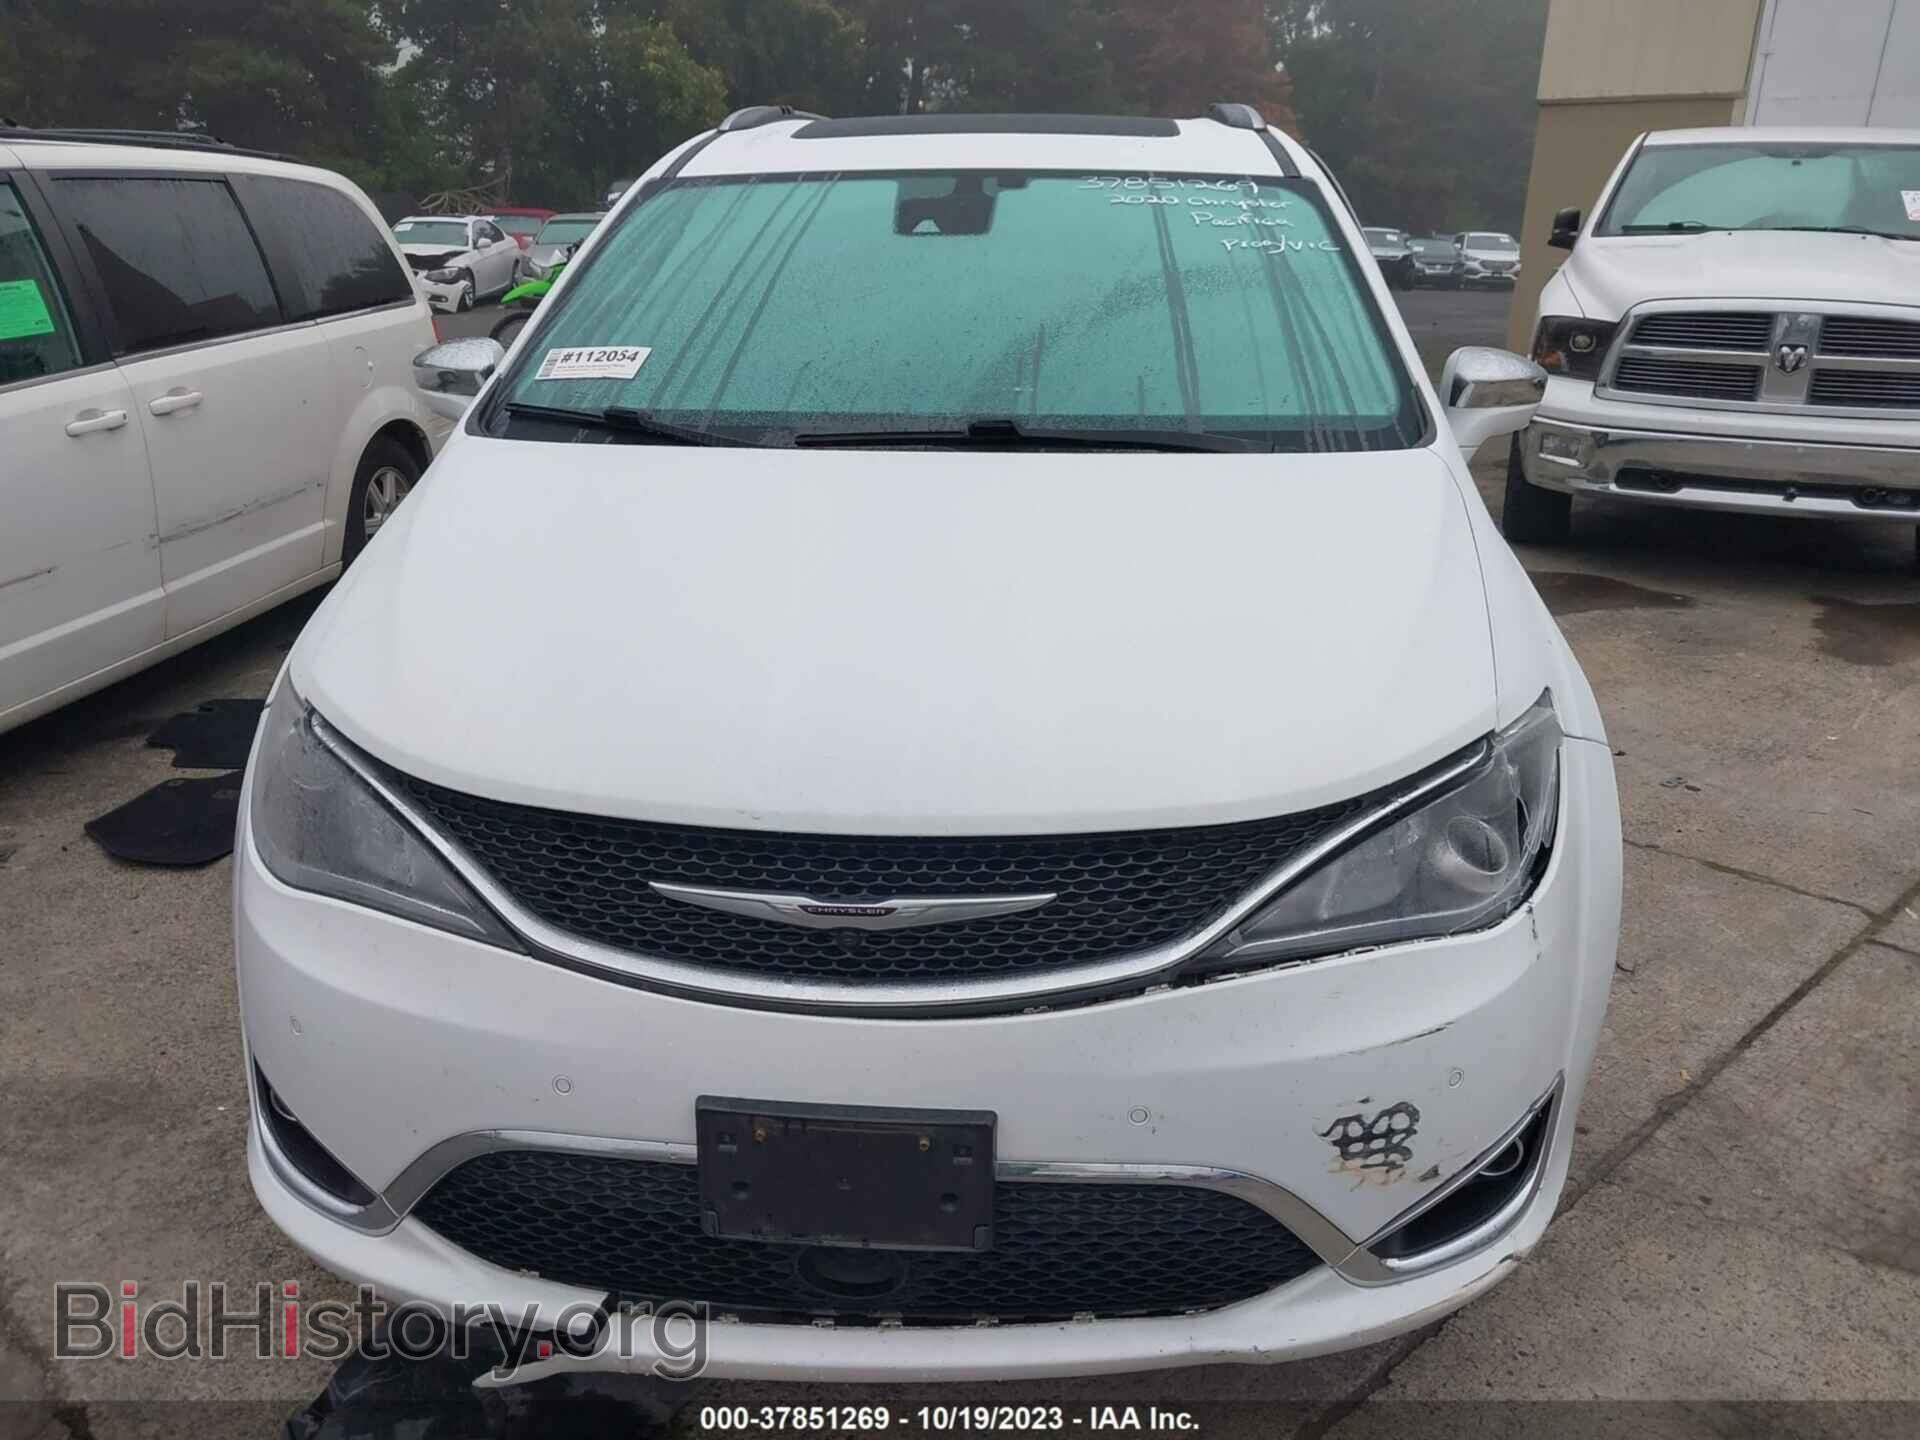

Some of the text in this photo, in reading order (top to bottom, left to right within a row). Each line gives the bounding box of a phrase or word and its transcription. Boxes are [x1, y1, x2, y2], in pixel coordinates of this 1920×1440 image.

[1080, 176, 1258, 194] 37851269
[1109, 194, 1179, 205] 2020
[560, 349, 640, 364] #112054
[807, 906, 886, 915] CHRYSLER
